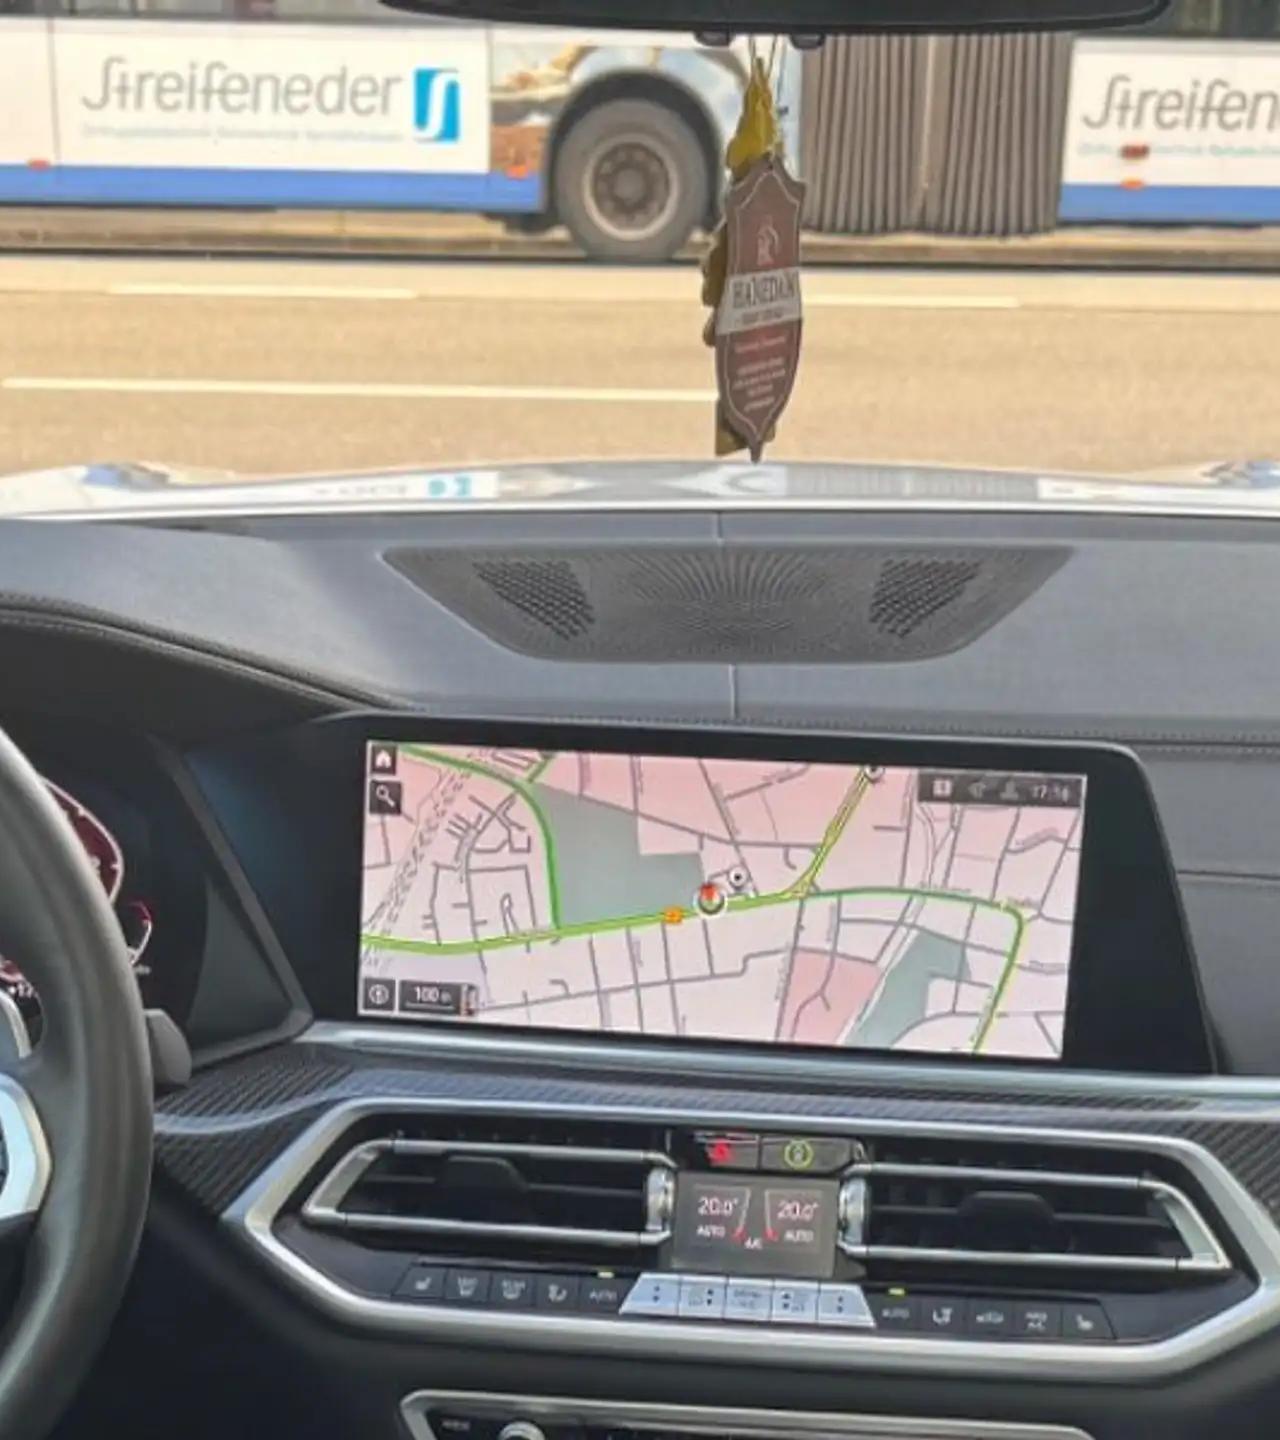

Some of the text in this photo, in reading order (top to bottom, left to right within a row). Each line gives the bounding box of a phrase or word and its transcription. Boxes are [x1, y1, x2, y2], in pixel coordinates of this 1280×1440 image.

[81, 55, 402, 117] Streifeneder
[415, 984, 440, 1002] 100
[696, 1225, 726, 1239] AUTO
[784, 1229, 815, 1243] AUTO
